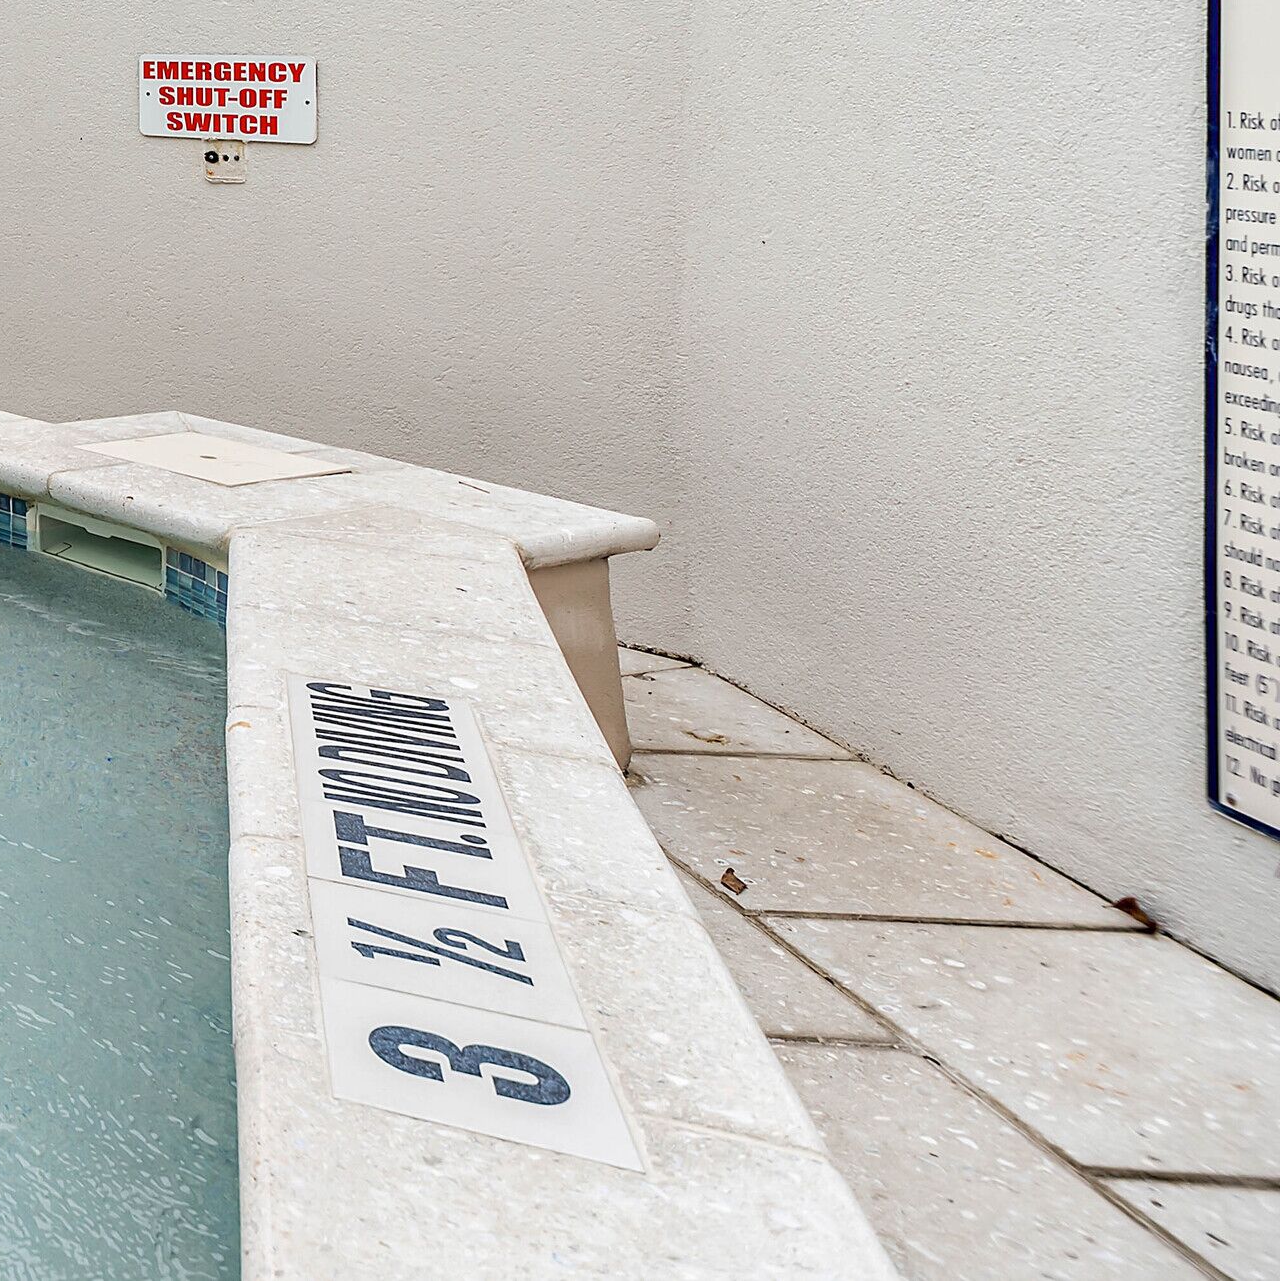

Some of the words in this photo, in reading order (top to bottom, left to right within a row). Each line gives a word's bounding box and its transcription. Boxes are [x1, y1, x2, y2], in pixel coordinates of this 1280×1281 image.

[142, 60, 307, 83] EMERGENCY
[157, 86, 289, 109] SHUT-OFF
[166, 112, 279, 136] SWITCH
[1226, 111, 1236, 128] 1.
[1240, 111, 1265, 130] Risk
[1226, 147, 1272, 161] women
[1226, 172, 1239, 190] 2.
[1243, 174, 1268, 192] Risk
[1225, 208, 1277, 224] pressure
[1225, 234, 1247, 252] and
[1225, 264, 1238, 282] 3.
[1242, 266, 1267, 286] Risk
[1225, 294, 1258, 319] drugs
[1225, 326, 1238, 344] 4.
[1242, 328, 1267, 349] Risk
[1225, 361, 1274, 384] nausea,
[1225, 417, 1237, 436] 5.
[1241, 420, 1266, 443] Risk
[1224, 446, 1265, 474] broken
[1224, 479, 1237, 498] 6.
[1240, 482, 1266, 506] Risk
[1224, 508, 1237, 528] 7.
[1240, 513, 1266, 537] Risk
[1224, 570, 1237, 590] 8.
[1240, 575, 1266, 599] Risk
[1224, 601, 1237, 622] 9.
[1240, 606, 1266, 631] Risk
[1247, 639, 1273, 664] Risk
[333, 810, 510, 910] FT.
[368, 1025, 572, 1106] 3
